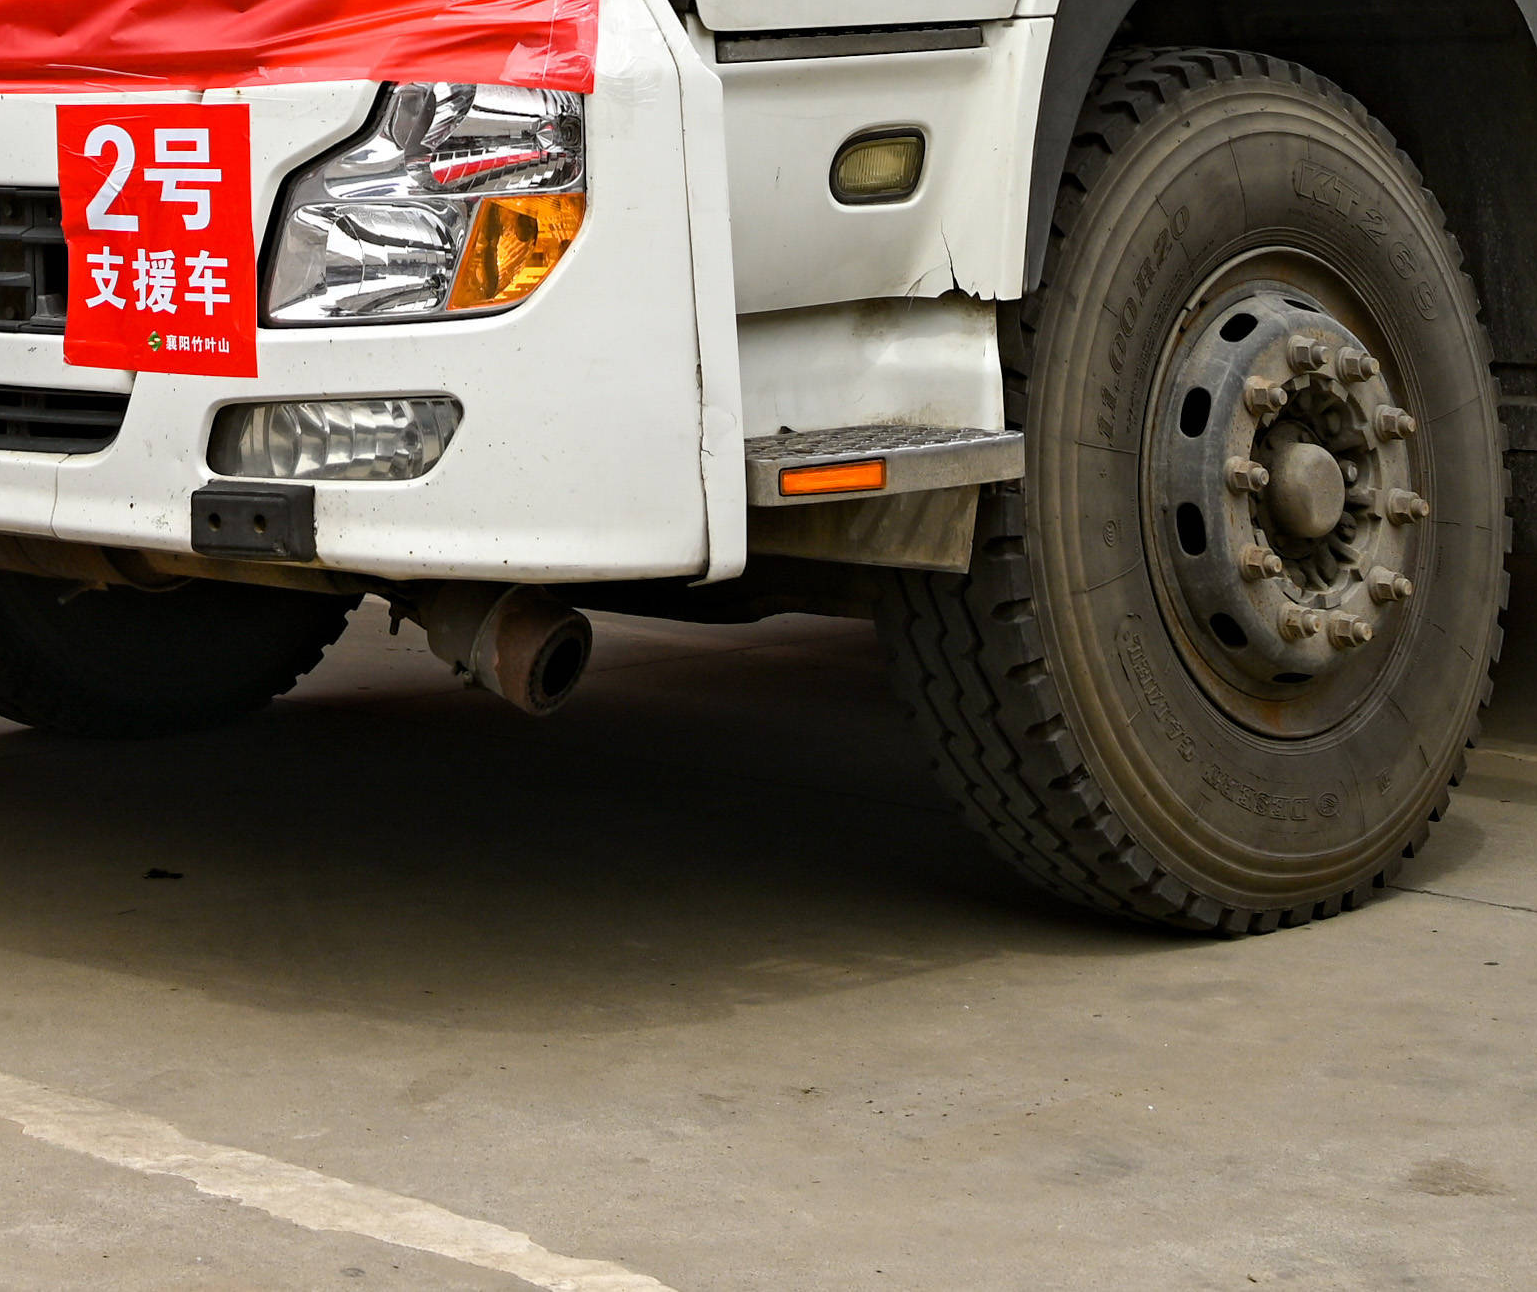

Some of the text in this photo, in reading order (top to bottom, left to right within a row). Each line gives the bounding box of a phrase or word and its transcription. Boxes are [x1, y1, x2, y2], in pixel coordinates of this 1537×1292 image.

[83, 124, 222, 232] 2号
[85, 246, 231, 316] 支援车
[165, 334, 230, 354] 襄阳竹叶山
